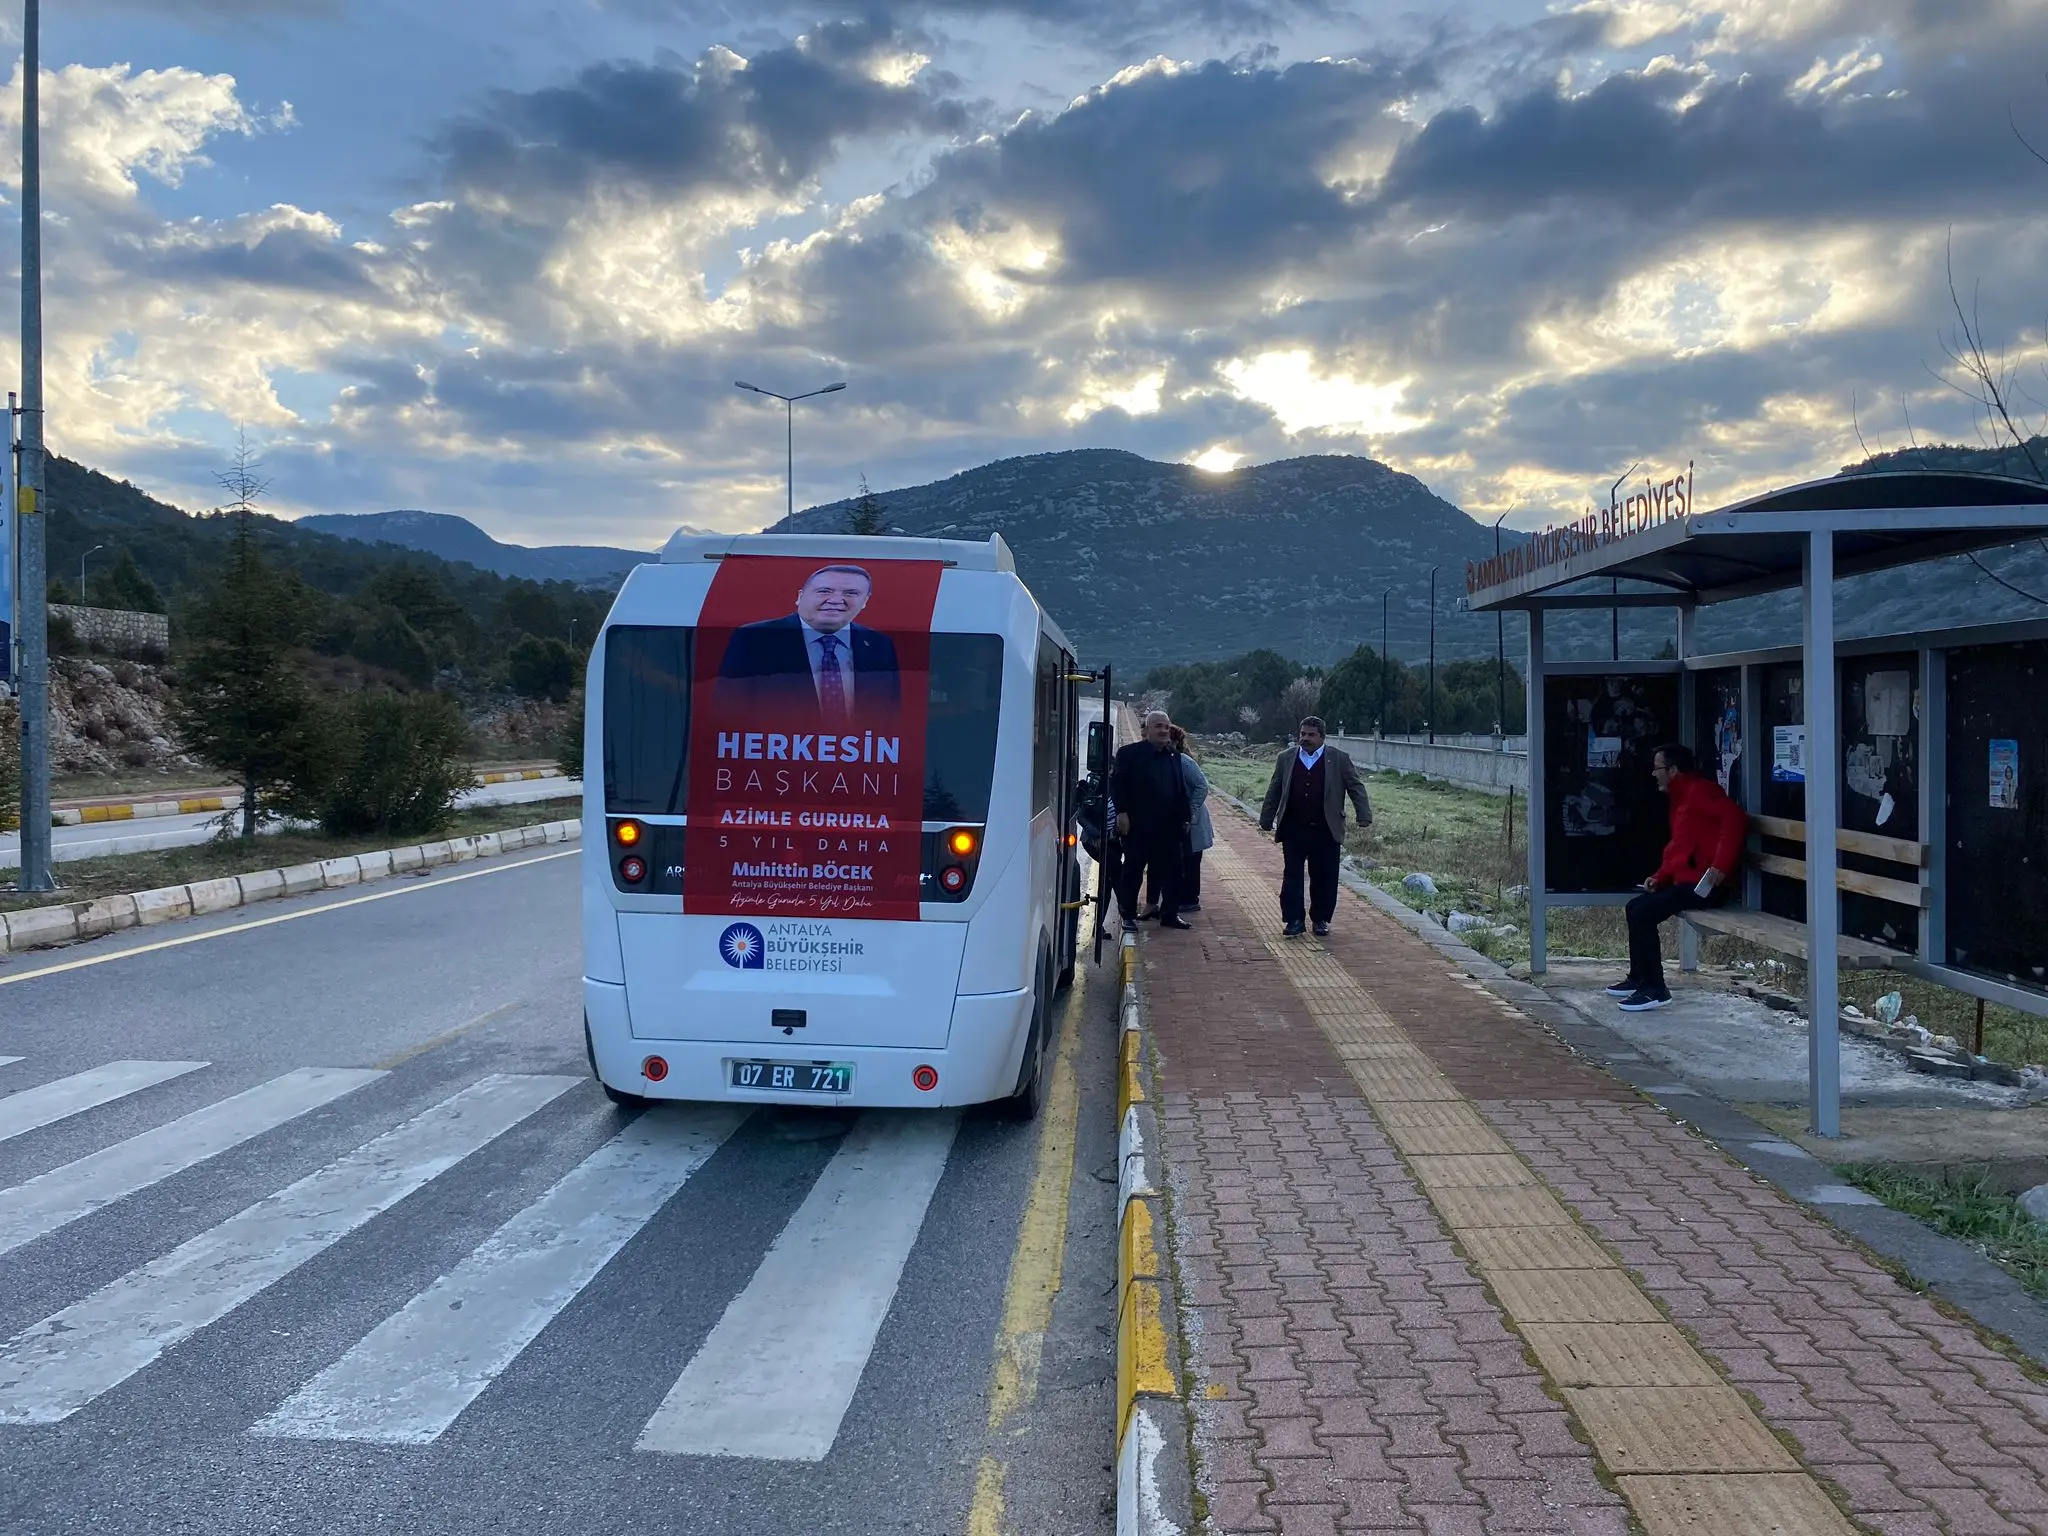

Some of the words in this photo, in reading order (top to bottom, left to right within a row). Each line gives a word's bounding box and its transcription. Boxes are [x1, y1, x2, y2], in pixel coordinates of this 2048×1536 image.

[1602, 460, 1694, 545] BELEDİYESİ
[717, 730, 900, 764] HERKESİN
[716, 768, 898, 796] BAŞKANI
[720, 807, 792, 826] AZİMLE
[798, 811, 890, 829] GURURLA
[719, 835, 728, 848] 5
[752, 836, 794, 850] YIL
[818, 839, 889, 853] DAHA
[732, 861, 808, 879] Muhittin
[812, 860, 873, 880] BÖCEK
[731, 880, 763, 891] Antalya
[763, 880, 807, 892] Büyükşehir
[808, 882, 842, 893] Belediye
[843, 883, 874, 893] Başkanı
[808, 894, 818, 907] 5
[841, 895, 873, 911] Daha
[768, 923, 832, 937] ANTALYA
[767, 937, 864, 957] BÜYÜKŞEHİR
[766, 956, 843, 972] BELEDİYESİ
[739, 1064, 763, 1085] 07
[772, 1066, 795, 1087] ER
[811, 1068, 844, 1090] 721
